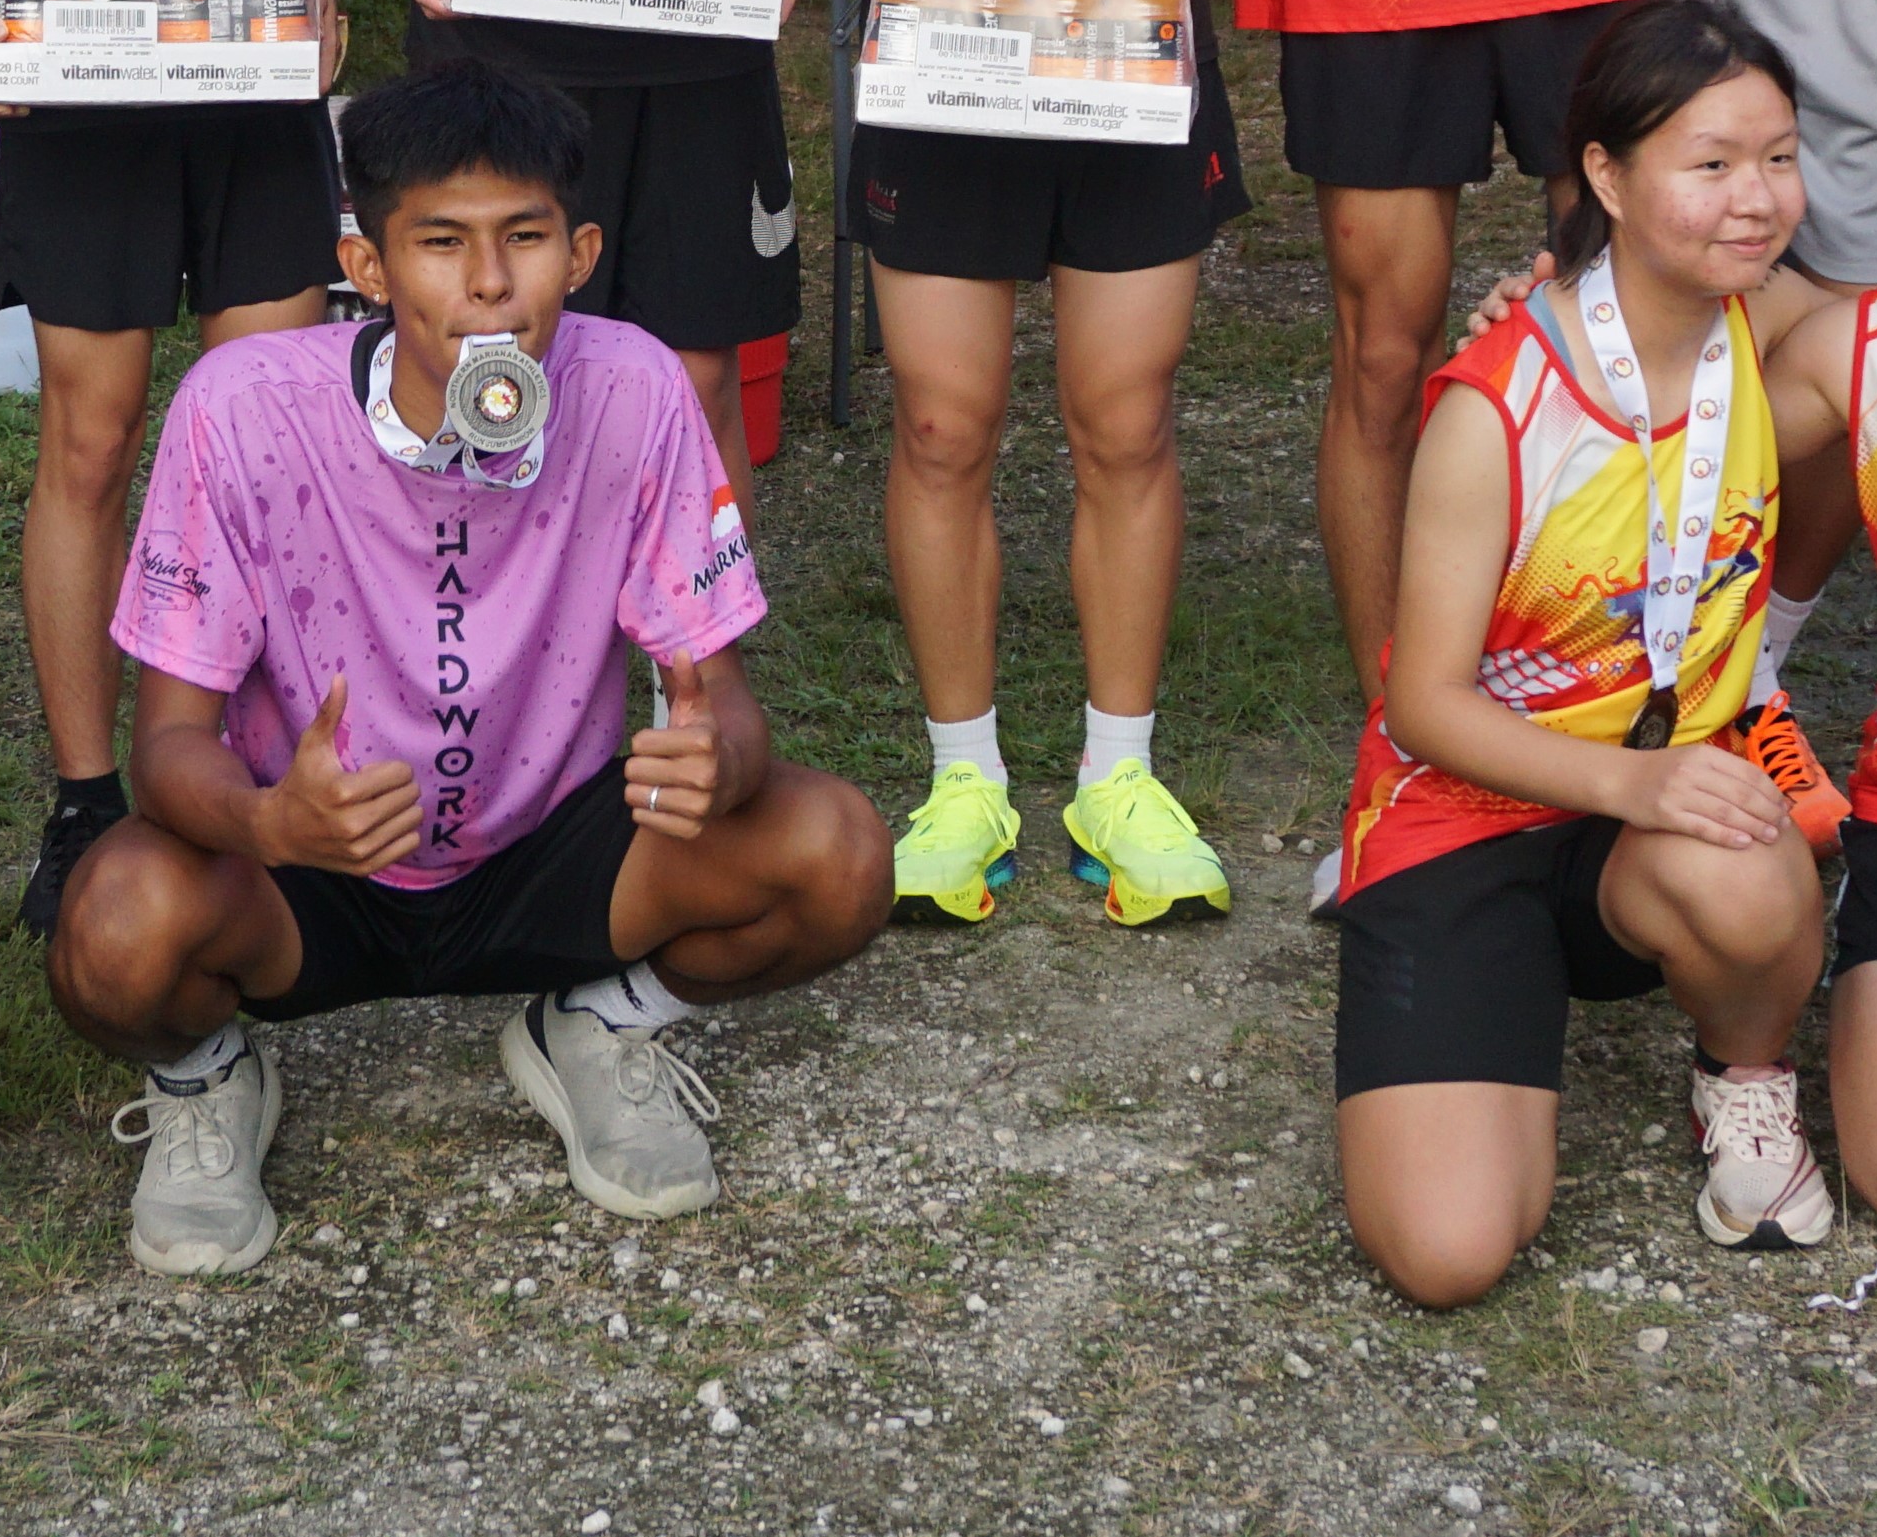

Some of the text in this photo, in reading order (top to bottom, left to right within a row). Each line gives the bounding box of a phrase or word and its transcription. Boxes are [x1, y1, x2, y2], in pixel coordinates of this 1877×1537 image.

[658, 11, 717, 26] zero sugar
[0, 64, 11, 73] 20
[0, 76, 40, 86] 12 COUNT
[197, 81, 257, 92] zero sugar
[866, 85, 877, 94] 20
[866, 98, 905, 108] 12 COUNT
[1063, 116, 1123, 131] zero sugar
[472, 350, 518, 364] MARIANAS
[450, 363, 471, 408] NORTHERN
[519, 358, 547, 400] ATHLETICS
[468, 427, 535, 448] RUN JUMP THROW
[140, 537, 184, 577] Hybrid
[182, 567, 211, 599] Shop
